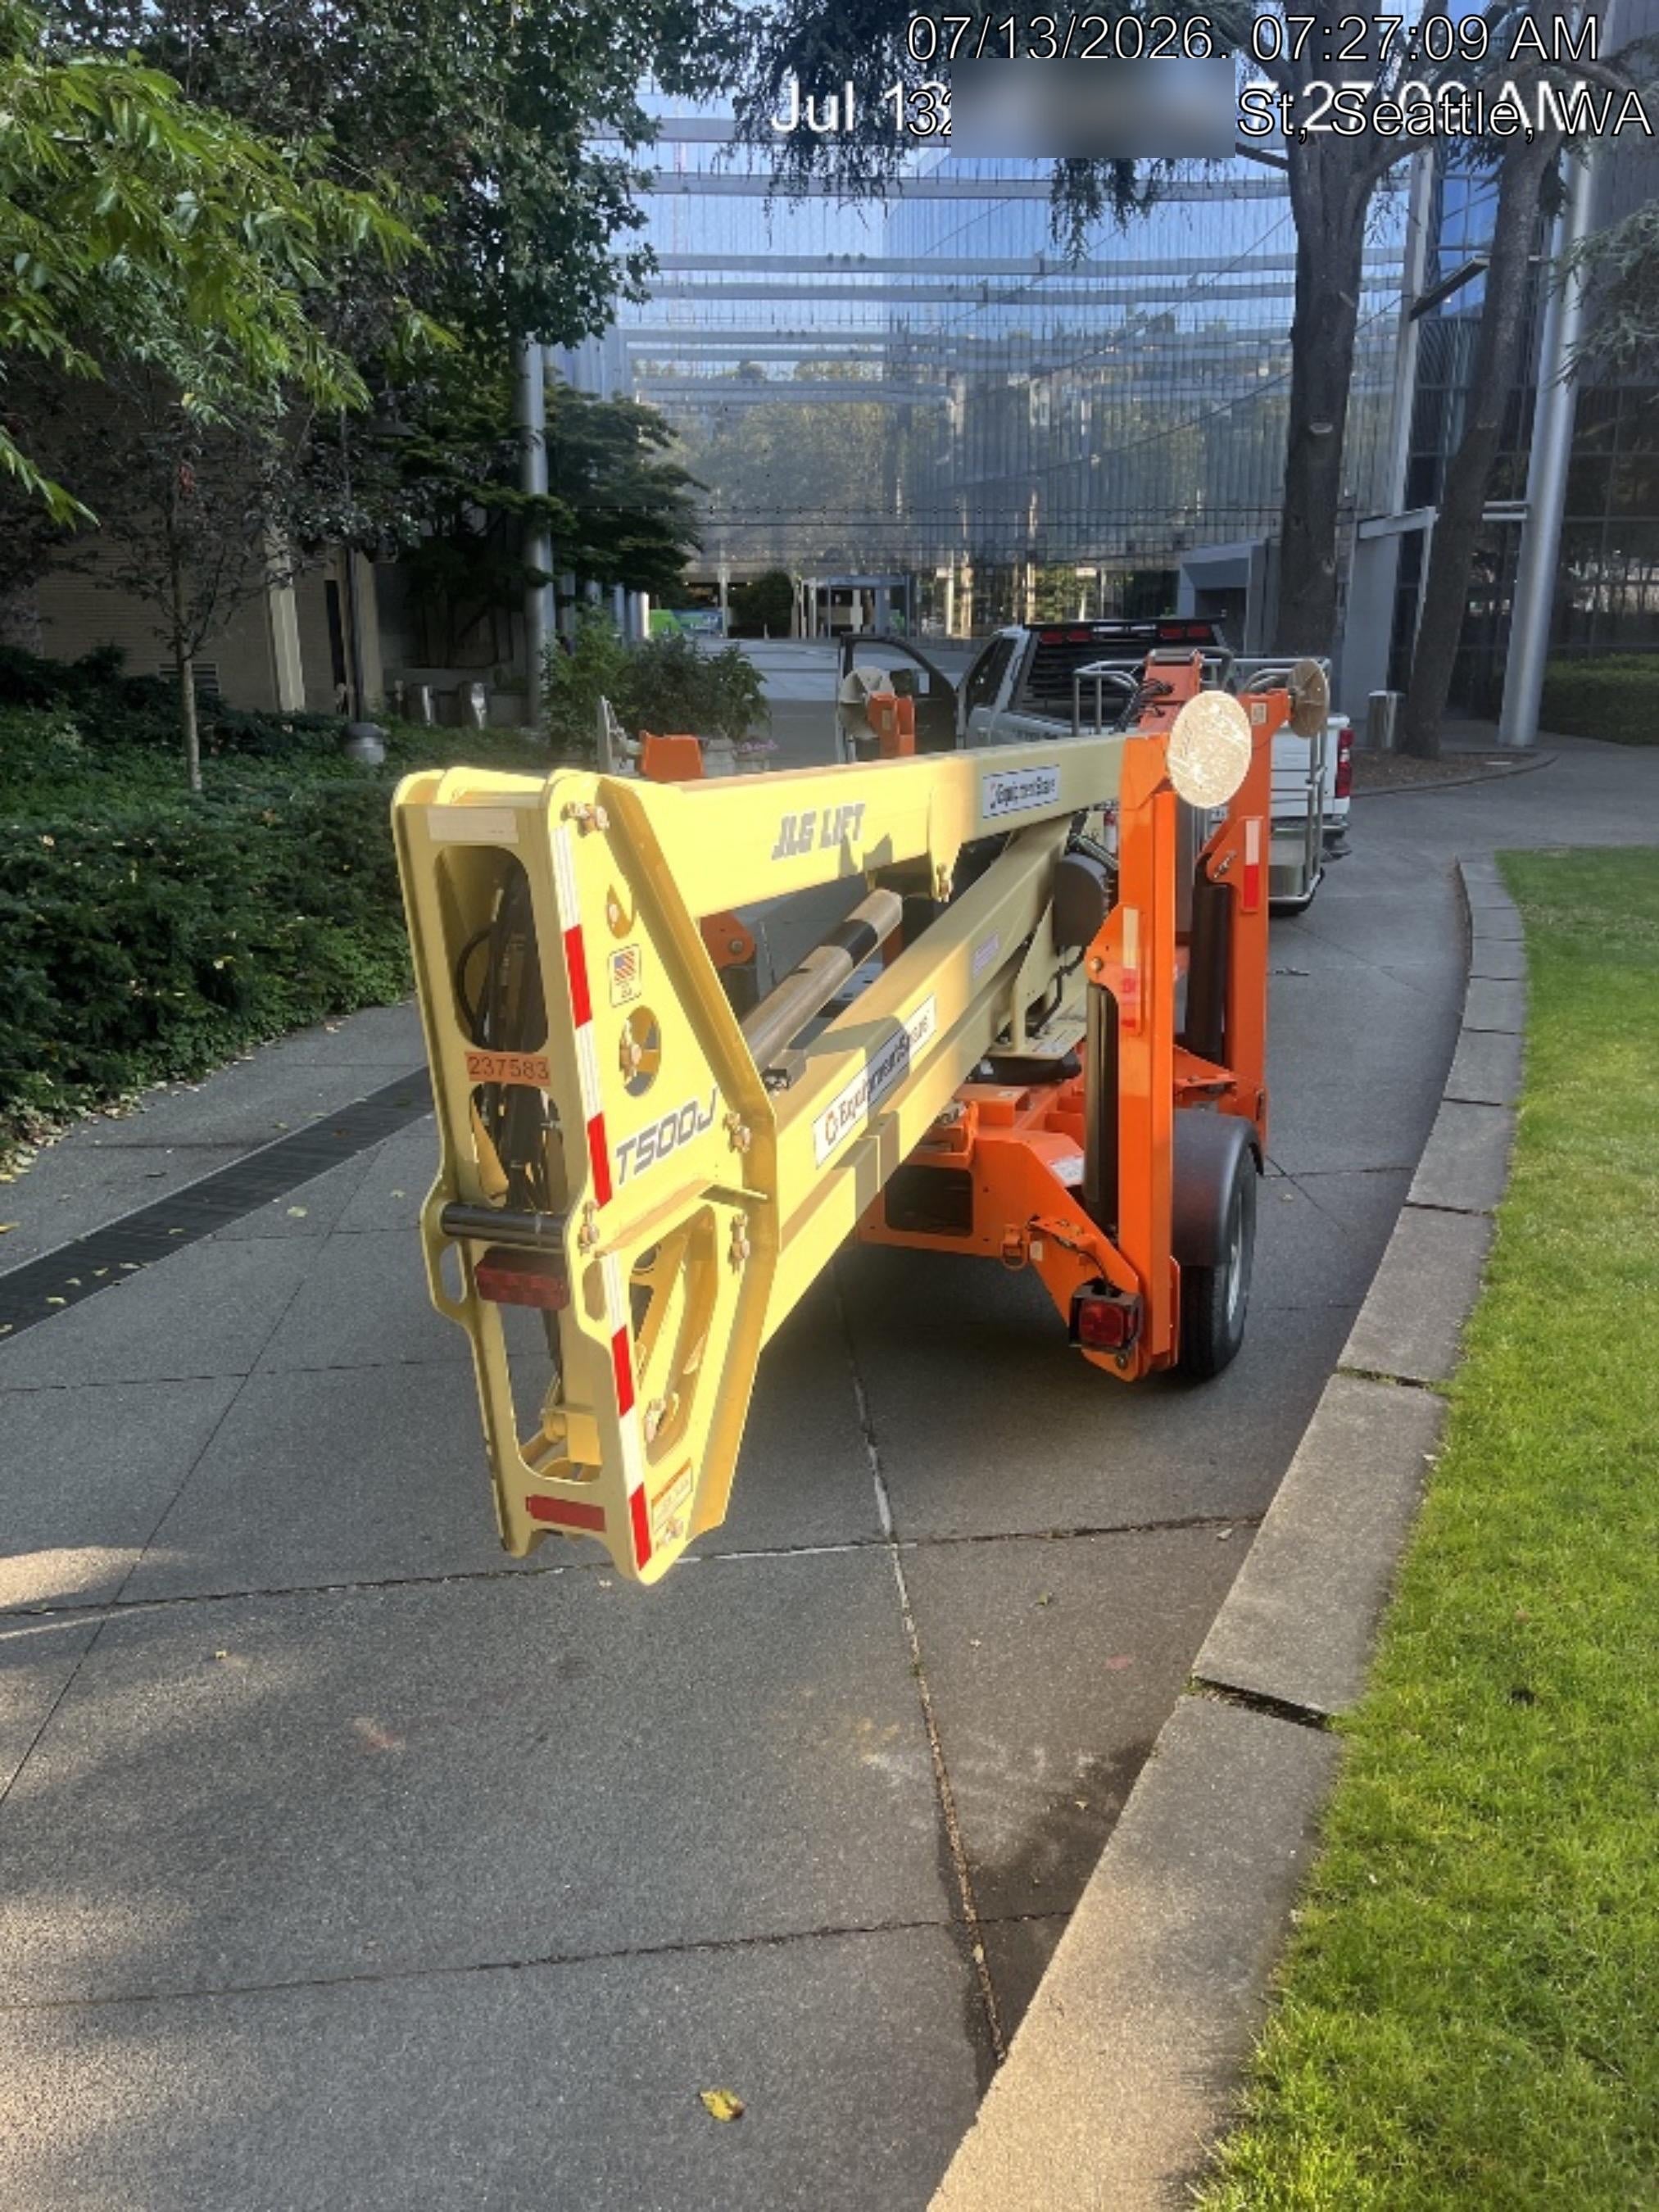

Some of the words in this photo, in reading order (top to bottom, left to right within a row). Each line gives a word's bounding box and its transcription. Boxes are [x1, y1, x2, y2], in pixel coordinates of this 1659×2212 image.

[818, 802, 866, 850] LIFT
[468, 1055, 549, 1080] 237583
[615, 1087, 717, 1185] T500J
